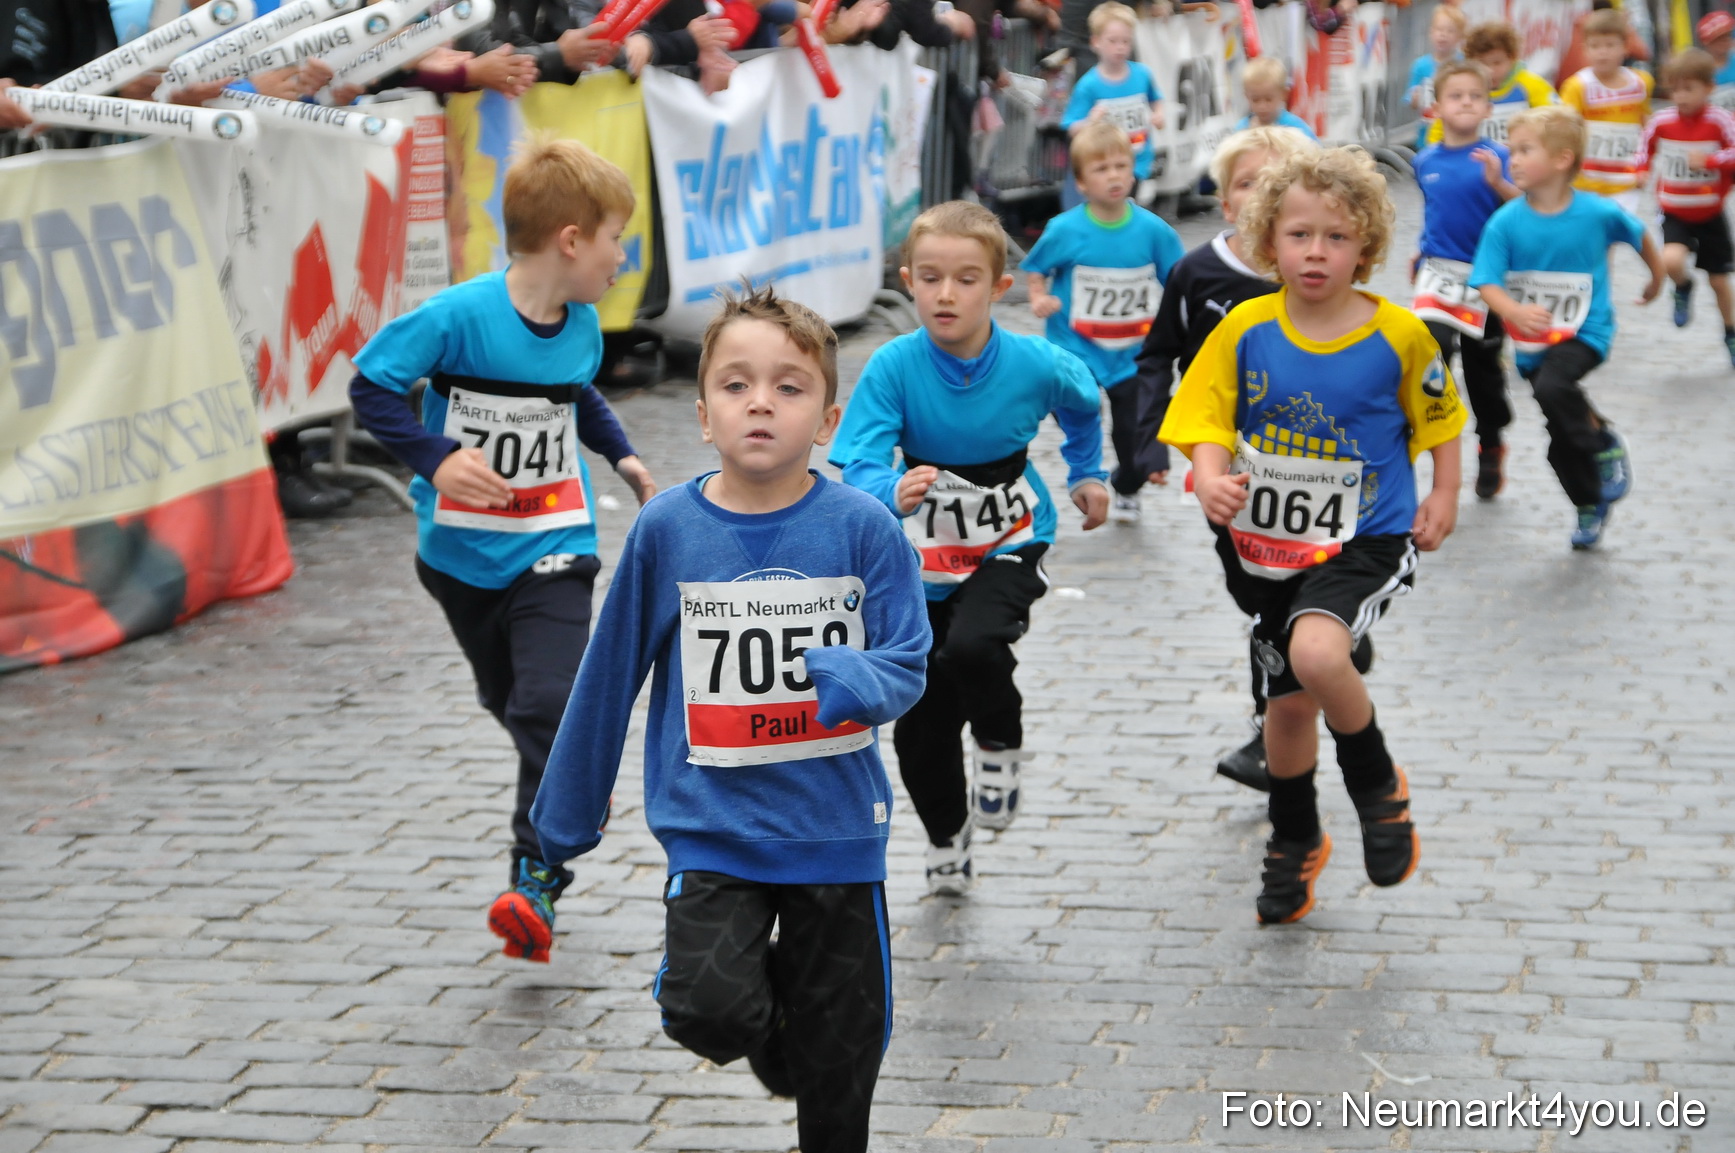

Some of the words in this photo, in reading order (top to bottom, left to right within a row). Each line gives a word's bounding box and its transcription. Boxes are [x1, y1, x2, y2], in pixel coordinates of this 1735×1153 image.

[293, 27, 350, 66] BMW
[293, 103, 349, 127] BMW
[1083, 286, 1149, 317] 7224
[451, 401, 502, 423] PARTL
[504, 406, 567, 425] Neumarkt
[461, 425, 567, 479] 7041
[1263, 466, 1336, 484] Neumarkt
[487, 493, 541, 513] ukas
[923, 479, 1031, 540] 7145
[1238, 471, 1344, 539] 064
[1240, 536, 1308, 565] Hannes
[684, 601, 742, 618] PARTL
[747, 596, 836, 617] Neumarkt
[750, 710, 807, 739] Paul
